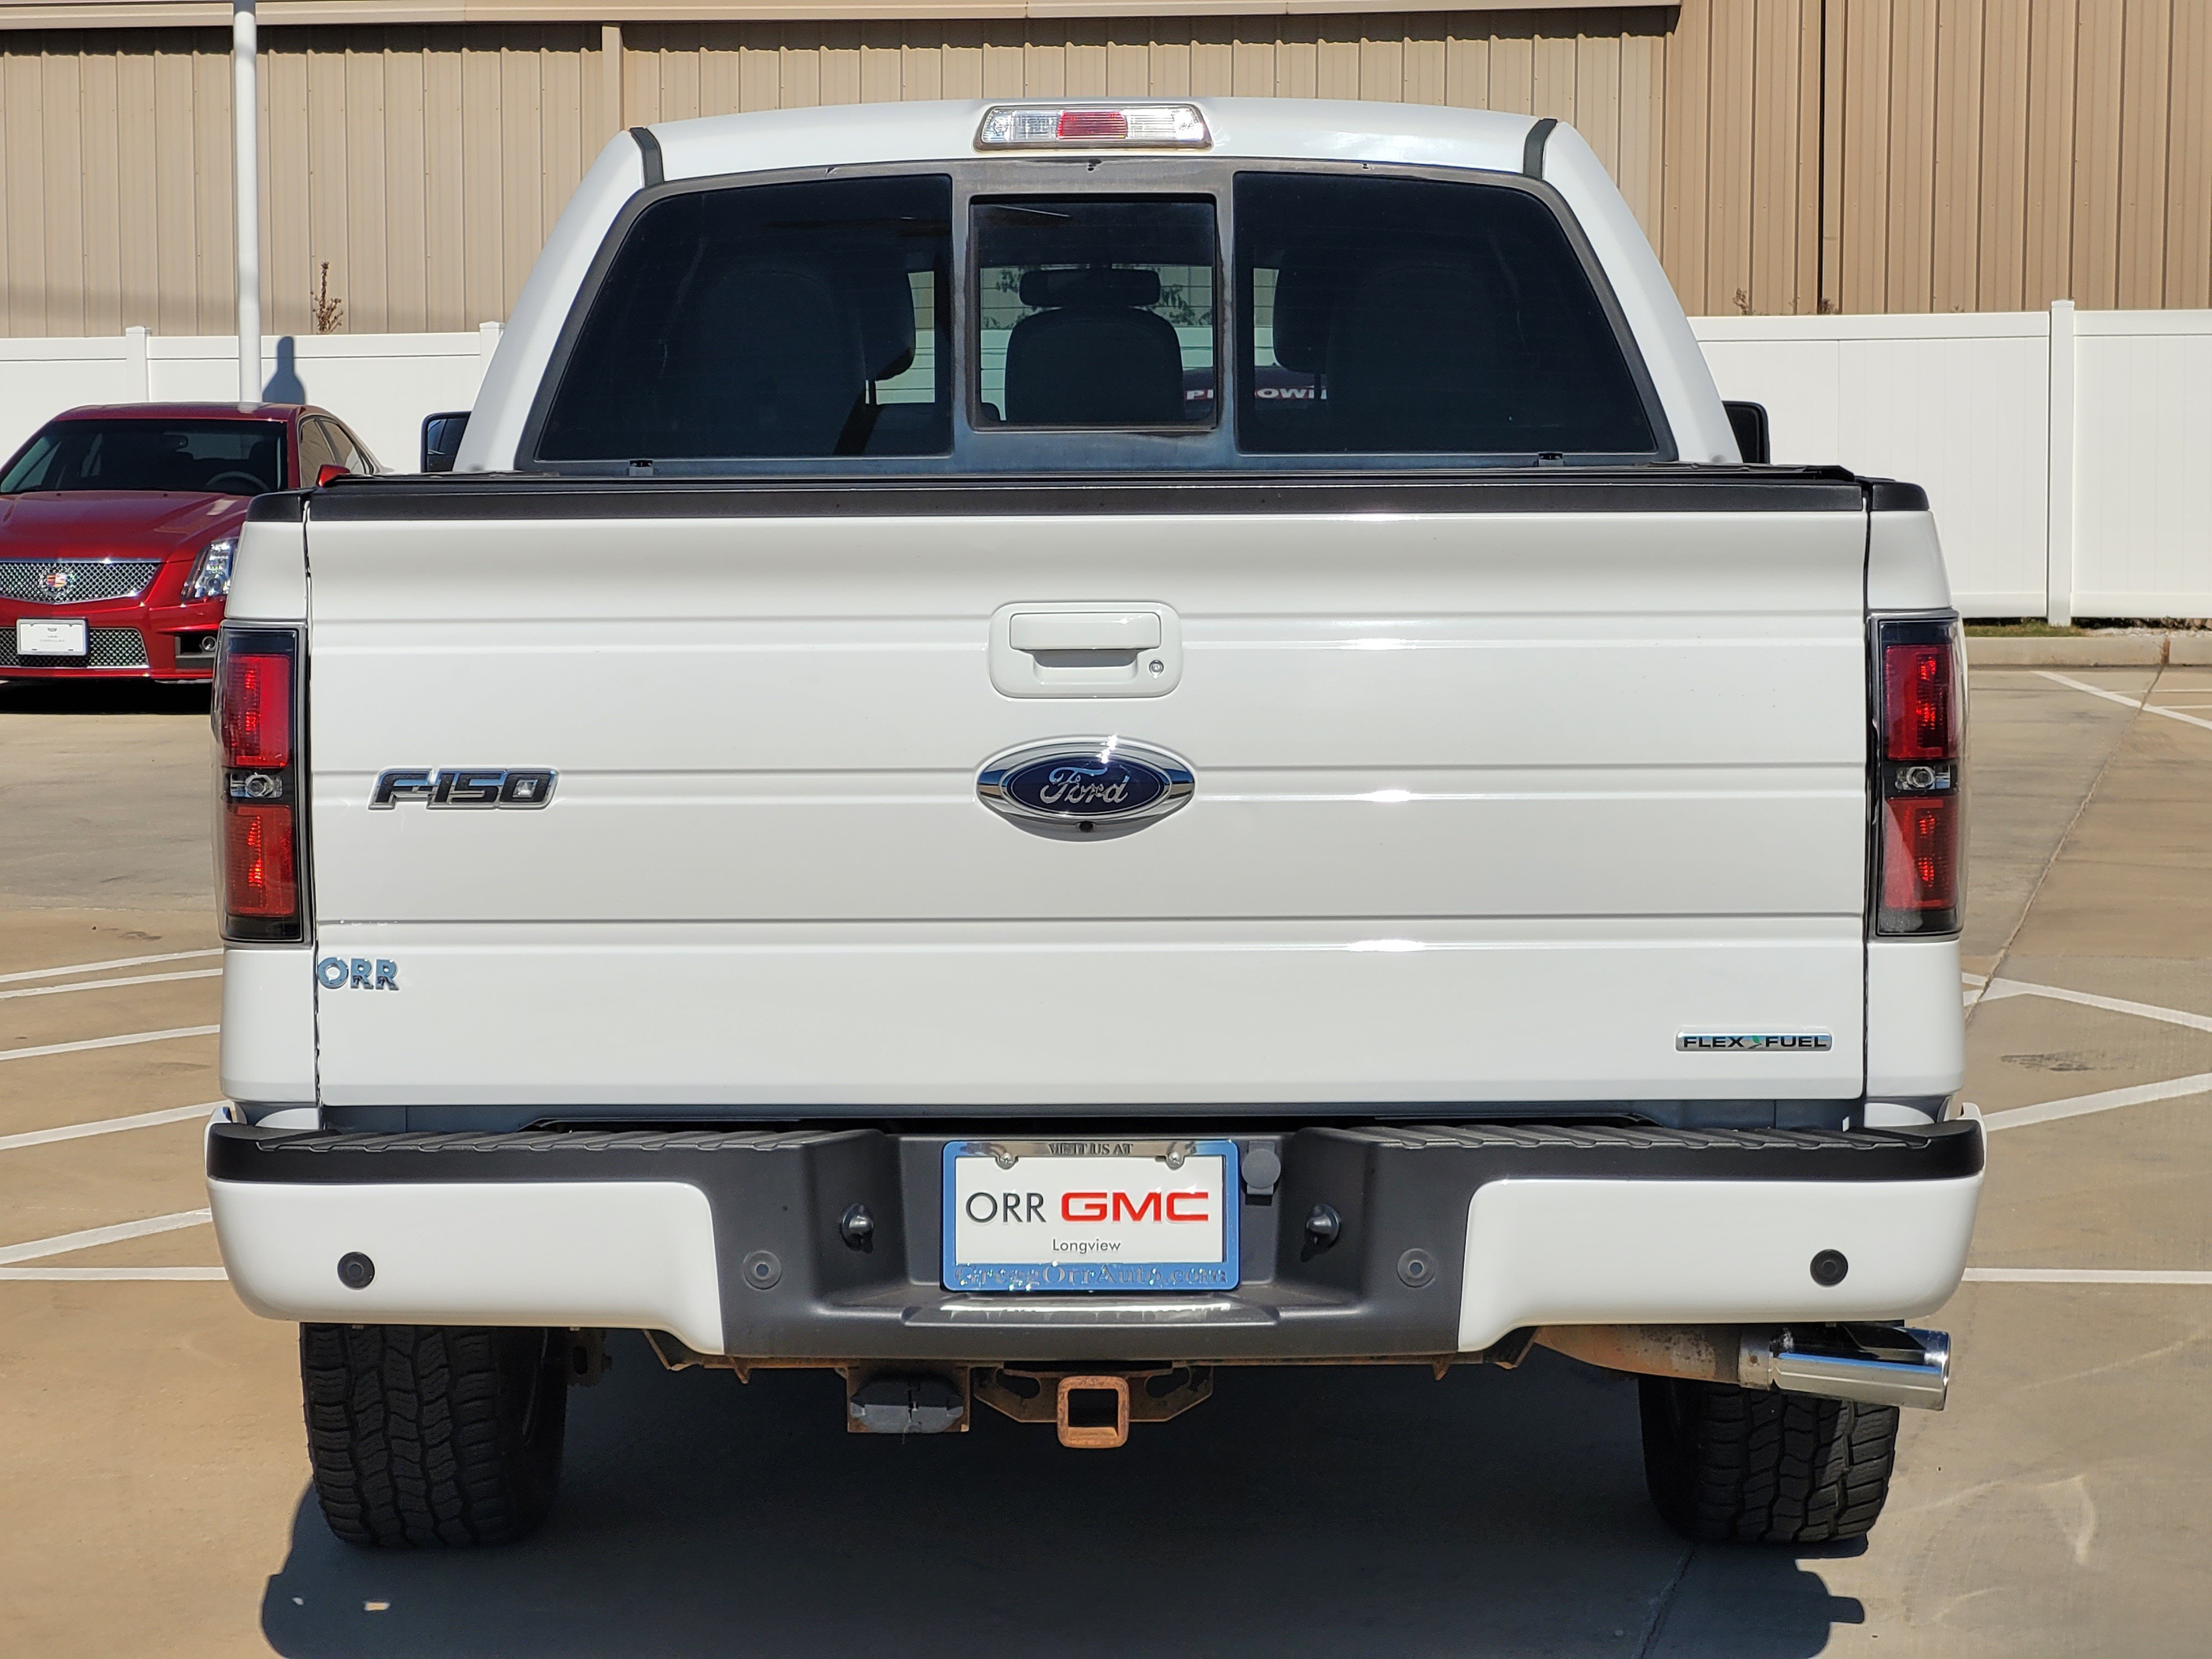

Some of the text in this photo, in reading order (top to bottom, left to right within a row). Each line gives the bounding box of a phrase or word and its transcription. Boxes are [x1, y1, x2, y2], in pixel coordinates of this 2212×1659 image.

[368, 768, 559, 810] F-150
[1040, 766, 1128, 804] Ford
[317, 957, 400, 991] ORR
[1683, 1036, 1827, 1048] FLEX FUEL
[1048, 1143, 1133, 1155] VISIT US AT
[966, 1192, 1209, 1223] ORR GMC
[1053, 1239, 1121, 1253] Longview
